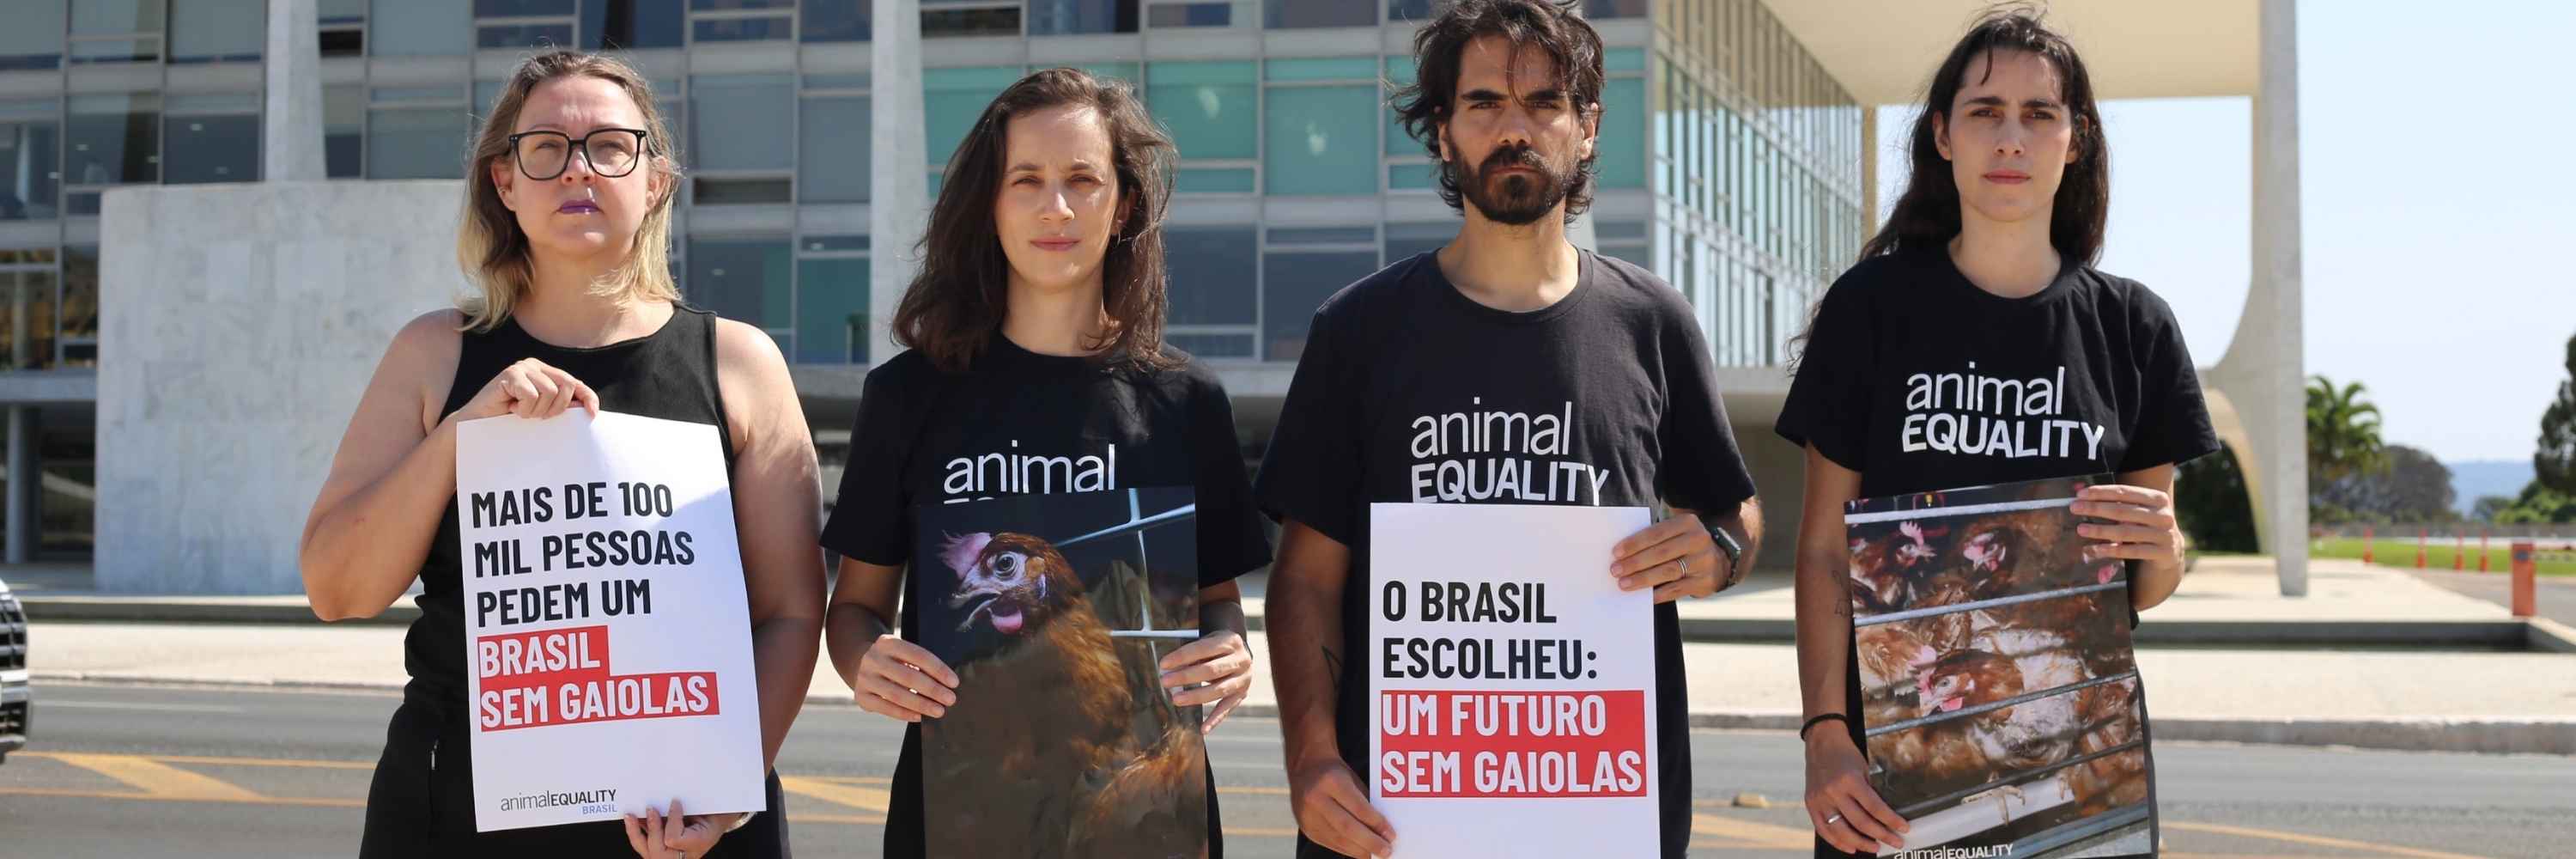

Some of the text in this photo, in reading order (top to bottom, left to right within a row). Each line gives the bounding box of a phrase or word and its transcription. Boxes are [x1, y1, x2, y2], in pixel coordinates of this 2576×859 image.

[1906, 362, 2065, 416] animal
[1411, 396, 1572, 459] animal
[1902, 412, 2105, 460] EQUALITY
[944, 440, 1115, 494] animal
[1411, 458, 1610, 506] EQUALITY
[471, 481, 673, 528] MAIS DE 100
[474, 530, 696, 578] MIL PESSOAS
[477, 579, 652, 628] PEDEM UM
[1382, 581, 1558, 624] O BRASIL
[478, 634, 601, 678] BRASIL
[1382, 637, 1598, 679] ESCOLHEU:
[480, 675, 709, 728] SEM GAIOLAS
[1382, 694, 1607, 736] UM FUTURO
[1382, 750, 1643, 793] SEM GAIOLAS
[500, 789, 617, 812] animalEQUALITY
[582, 803, 618, 815] BRASIL
